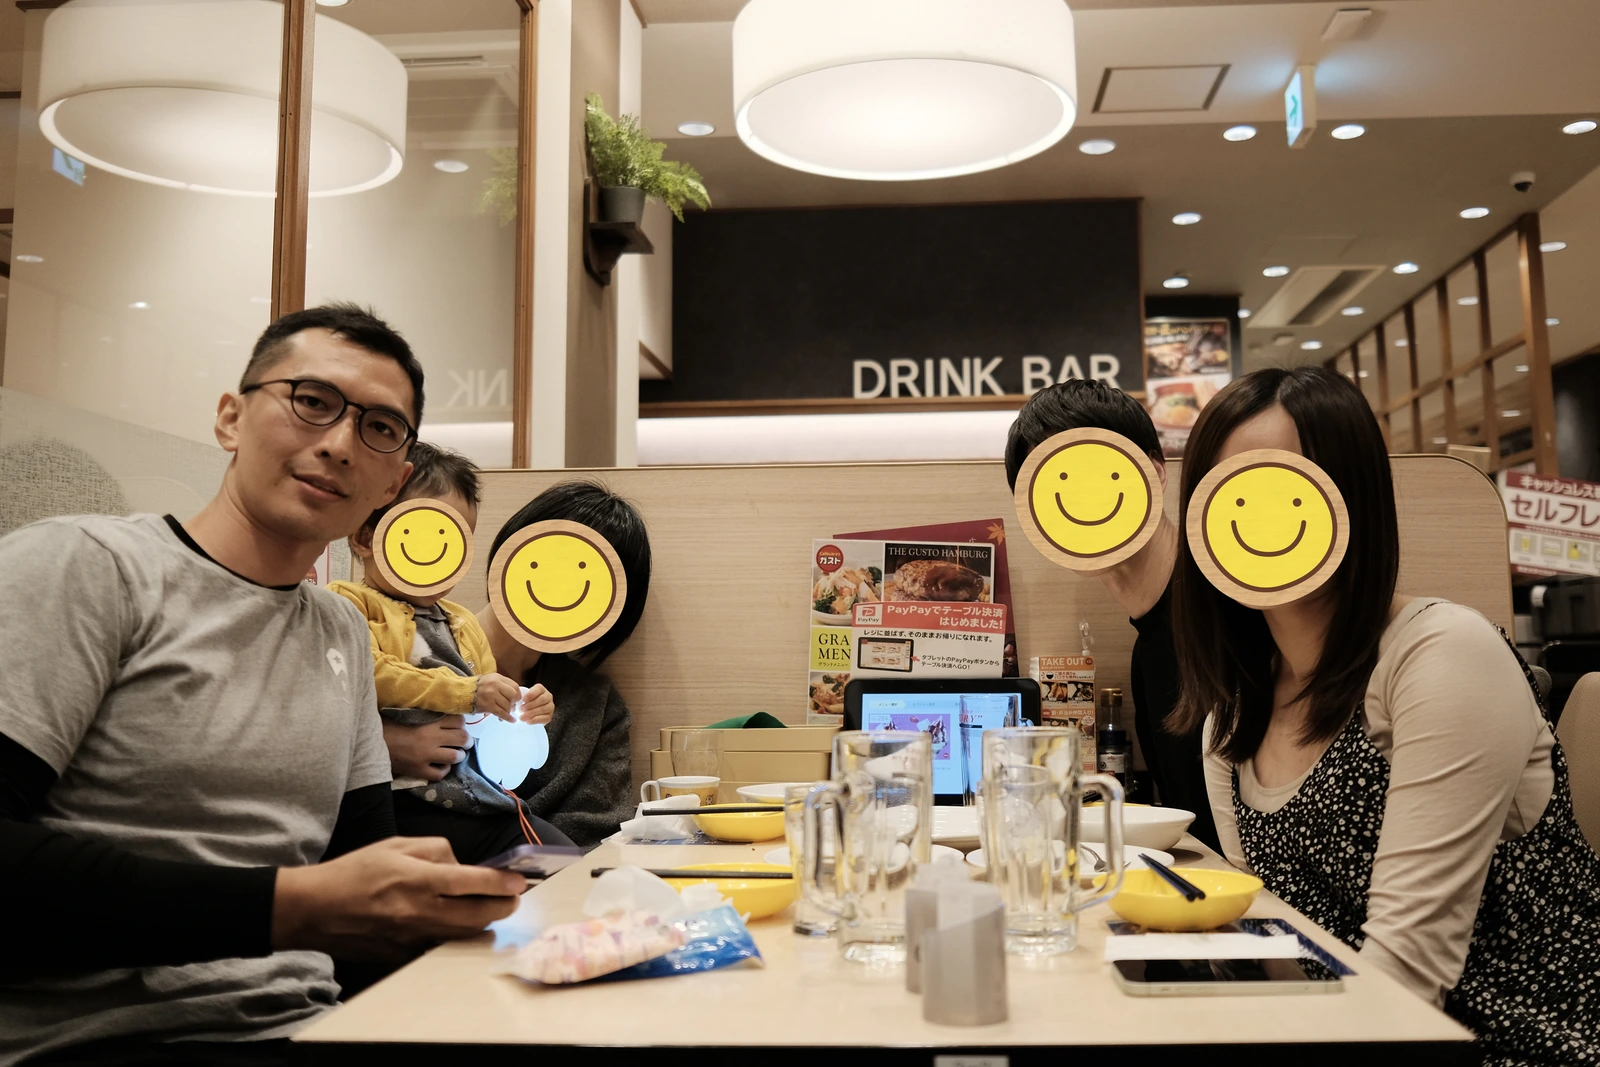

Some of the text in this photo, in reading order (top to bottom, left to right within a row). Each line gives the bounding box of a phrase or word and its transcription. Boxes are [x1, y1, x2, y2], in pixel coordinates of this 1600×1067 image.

[853, 353, 1123, 399] DRINK BAR
[1511, 494, 1600, 528] セルフレ
[888, 547, 988, 559] THE GUSTO HAMBURG
[819, 556, 841, 565] ガスト
[887, 605, 1003, 619] PayPayでテーブル決済
[939, 617, 1003, 629] はじめました!
[818, 633, 850, 646] GRA
[864, 630, 993, 643] レジに並ばず、そのままお帰りになれます。
[921, 655, 1000, 667] タブレットのPayPayボタンから
[1041, 657, 1065, 666] TAKE
[1066, 657, 1085, 666] OUT
